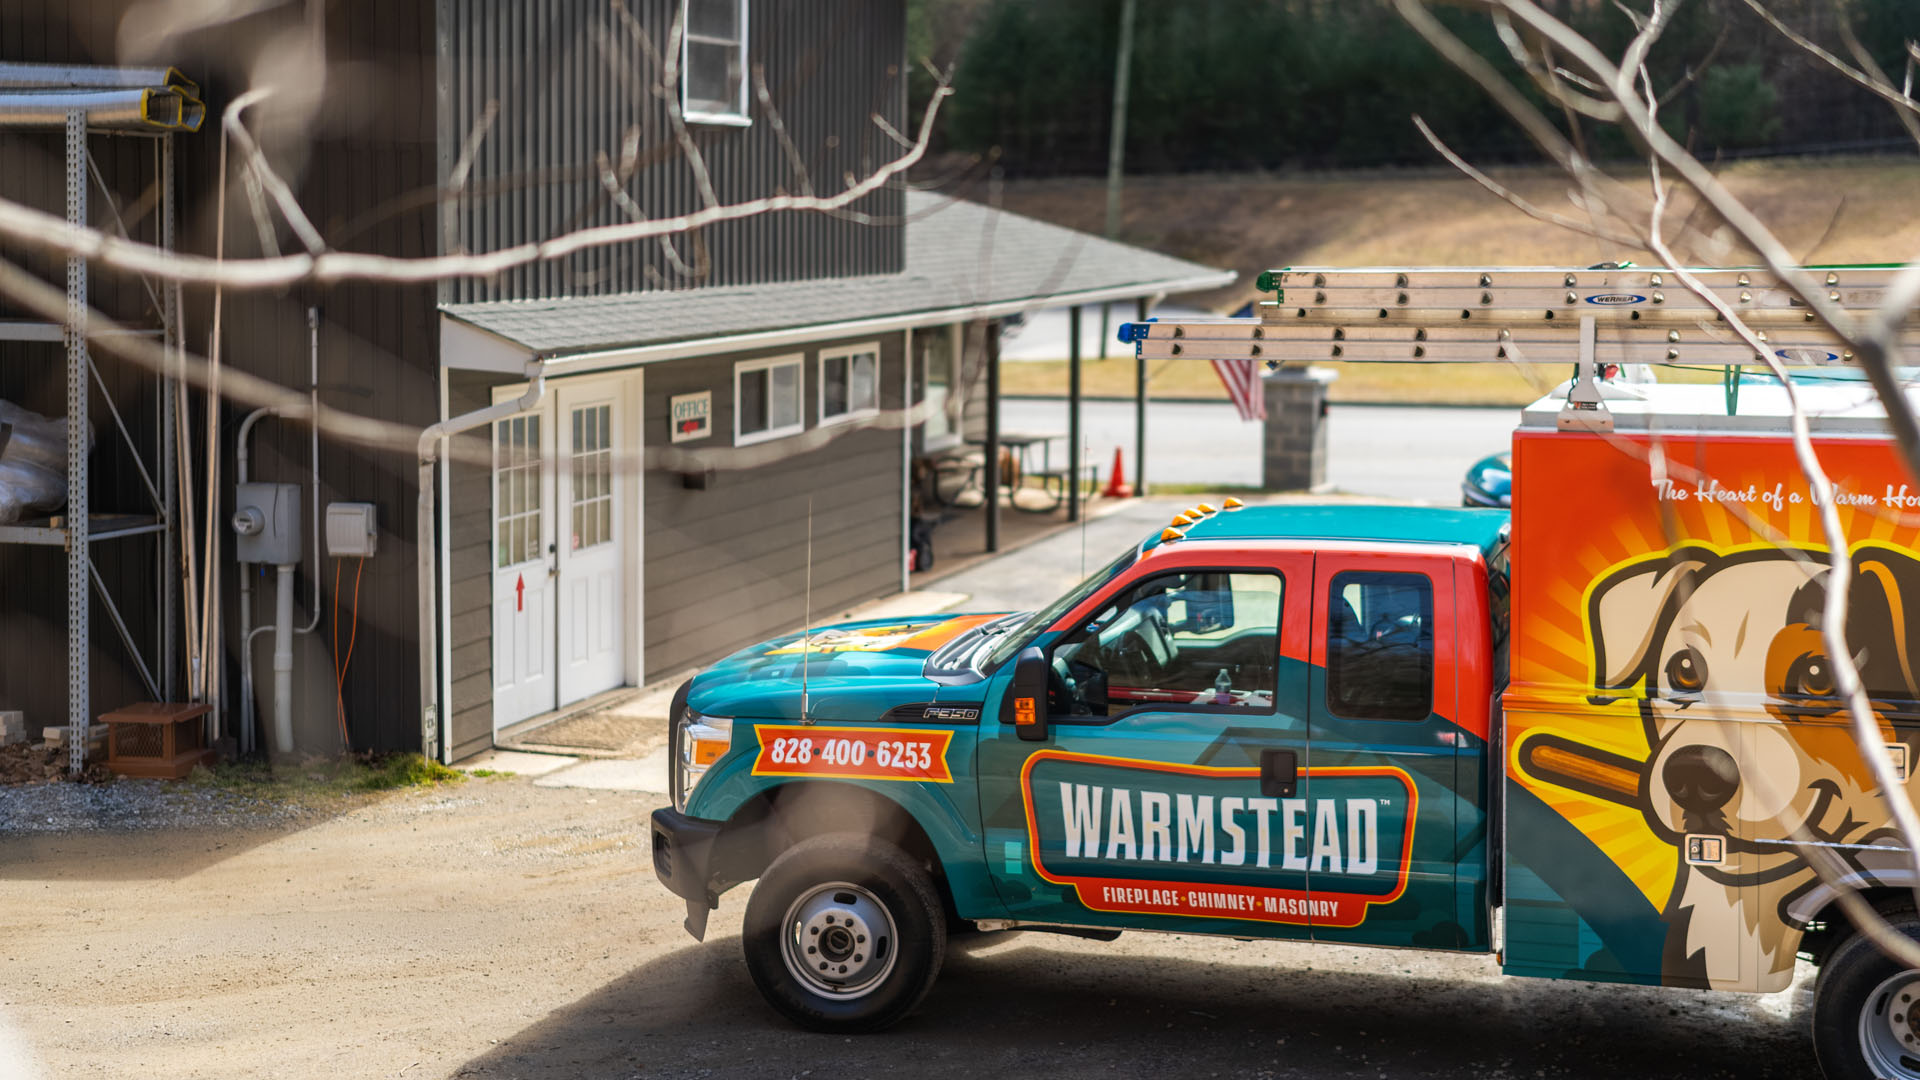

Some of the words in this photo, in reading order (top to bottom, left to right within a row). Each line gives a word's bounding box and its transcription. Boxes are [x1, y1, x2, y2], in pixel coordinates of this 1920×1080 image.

[1597, 295, 1634, 303] WERNER
[674, 399, 708, 419] OFFICE
[1651, 479, 1689, 502] The
[1693, 479, 1758, 503] Heart
[1761, 482, 1784, 512] of
[1788, 491, 1804, 504] a
[1882, 484, 1920, 508] Ho
[1059, 781, 1378, 875] WARMSTEAD
[1103, 886, 1179, 906] FIREPLACE
[1188, 891, 1256, 911] CHIMNEY
[1264, 896, 1339, 918] MASONRY
